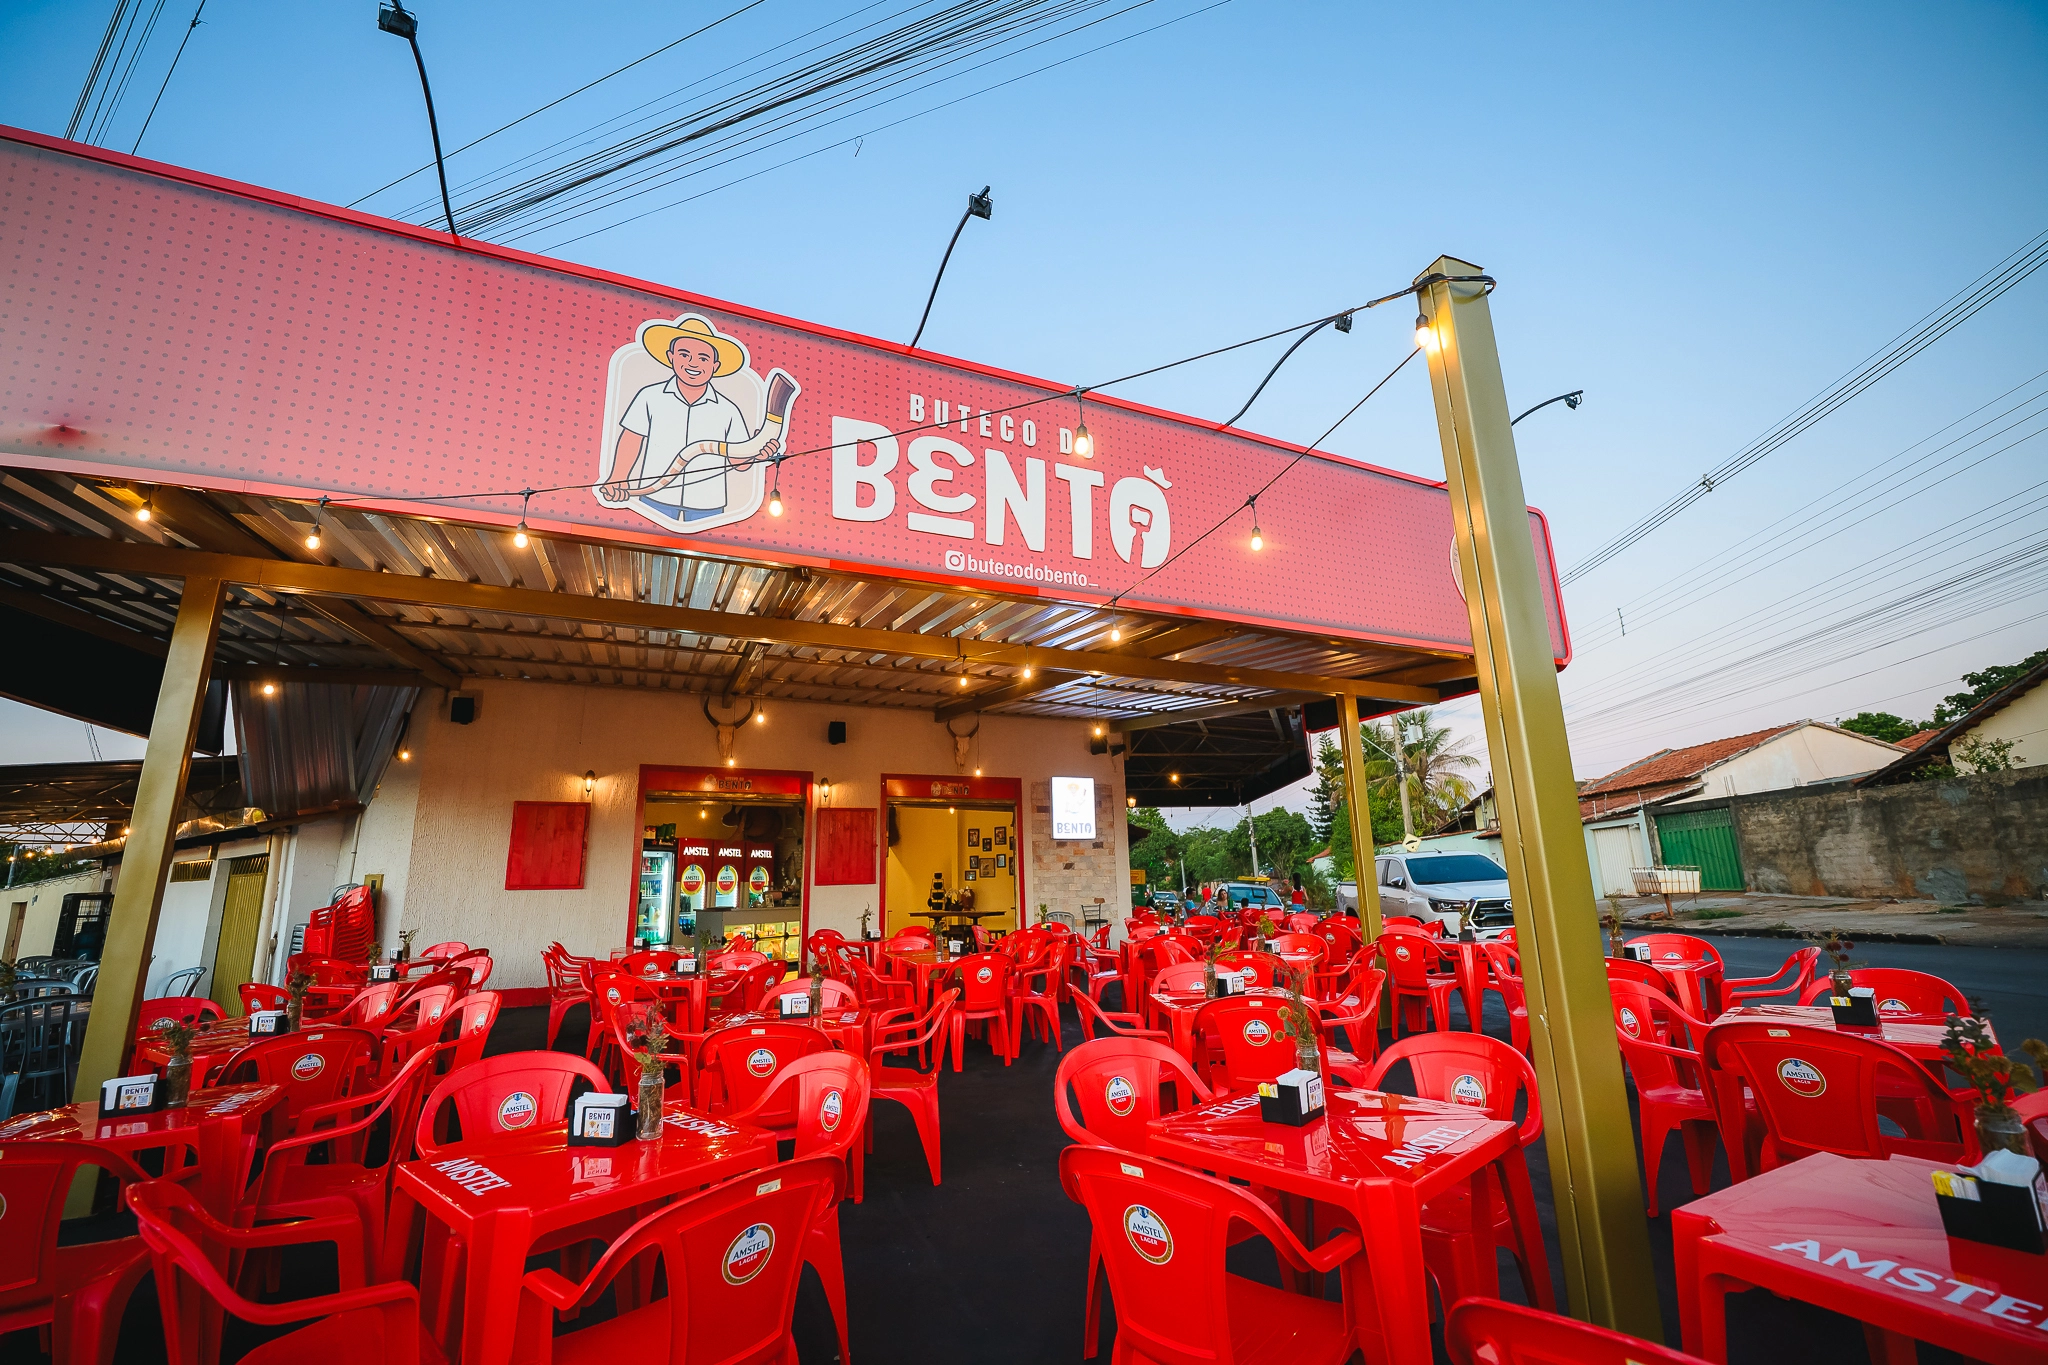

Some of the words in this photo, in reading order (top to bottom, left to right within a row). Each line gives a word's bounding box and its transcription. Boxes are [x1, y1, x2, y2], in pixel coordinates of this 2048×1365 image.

[910, 394, 1037, 447] BUTECO
[832, 416, 1172, 569] BENTO
[1057, 822, 1092, 834] BENTO
[683, 846, 710, 856] AMSTEL
[718, 848, 742, 858] AMSTEL
[751, 849, 772, 859] AMSTEL
[1786, 1070, 1817, 1080] AMSTEL
[1111, 1089, 1130, 1098] AMSTEL
[1457, 1088, 1480, 1098] AMSTEL
[505, 1104, 530, 1113] AMSTEL
[588, 1112, 611, 1120] BENTO
[1382, 1126, 1472, 1169] AMSTEL
[430, 1157, 512, 1196] AMSTEL
[1132, 1222, 1163, 1239] AMSTEL
[1140, 1235, 1158, 1246] LAGER
[733, 1240, 766, 1260] AMSTEL
[738, 1253, 758, 1267] LAGER
